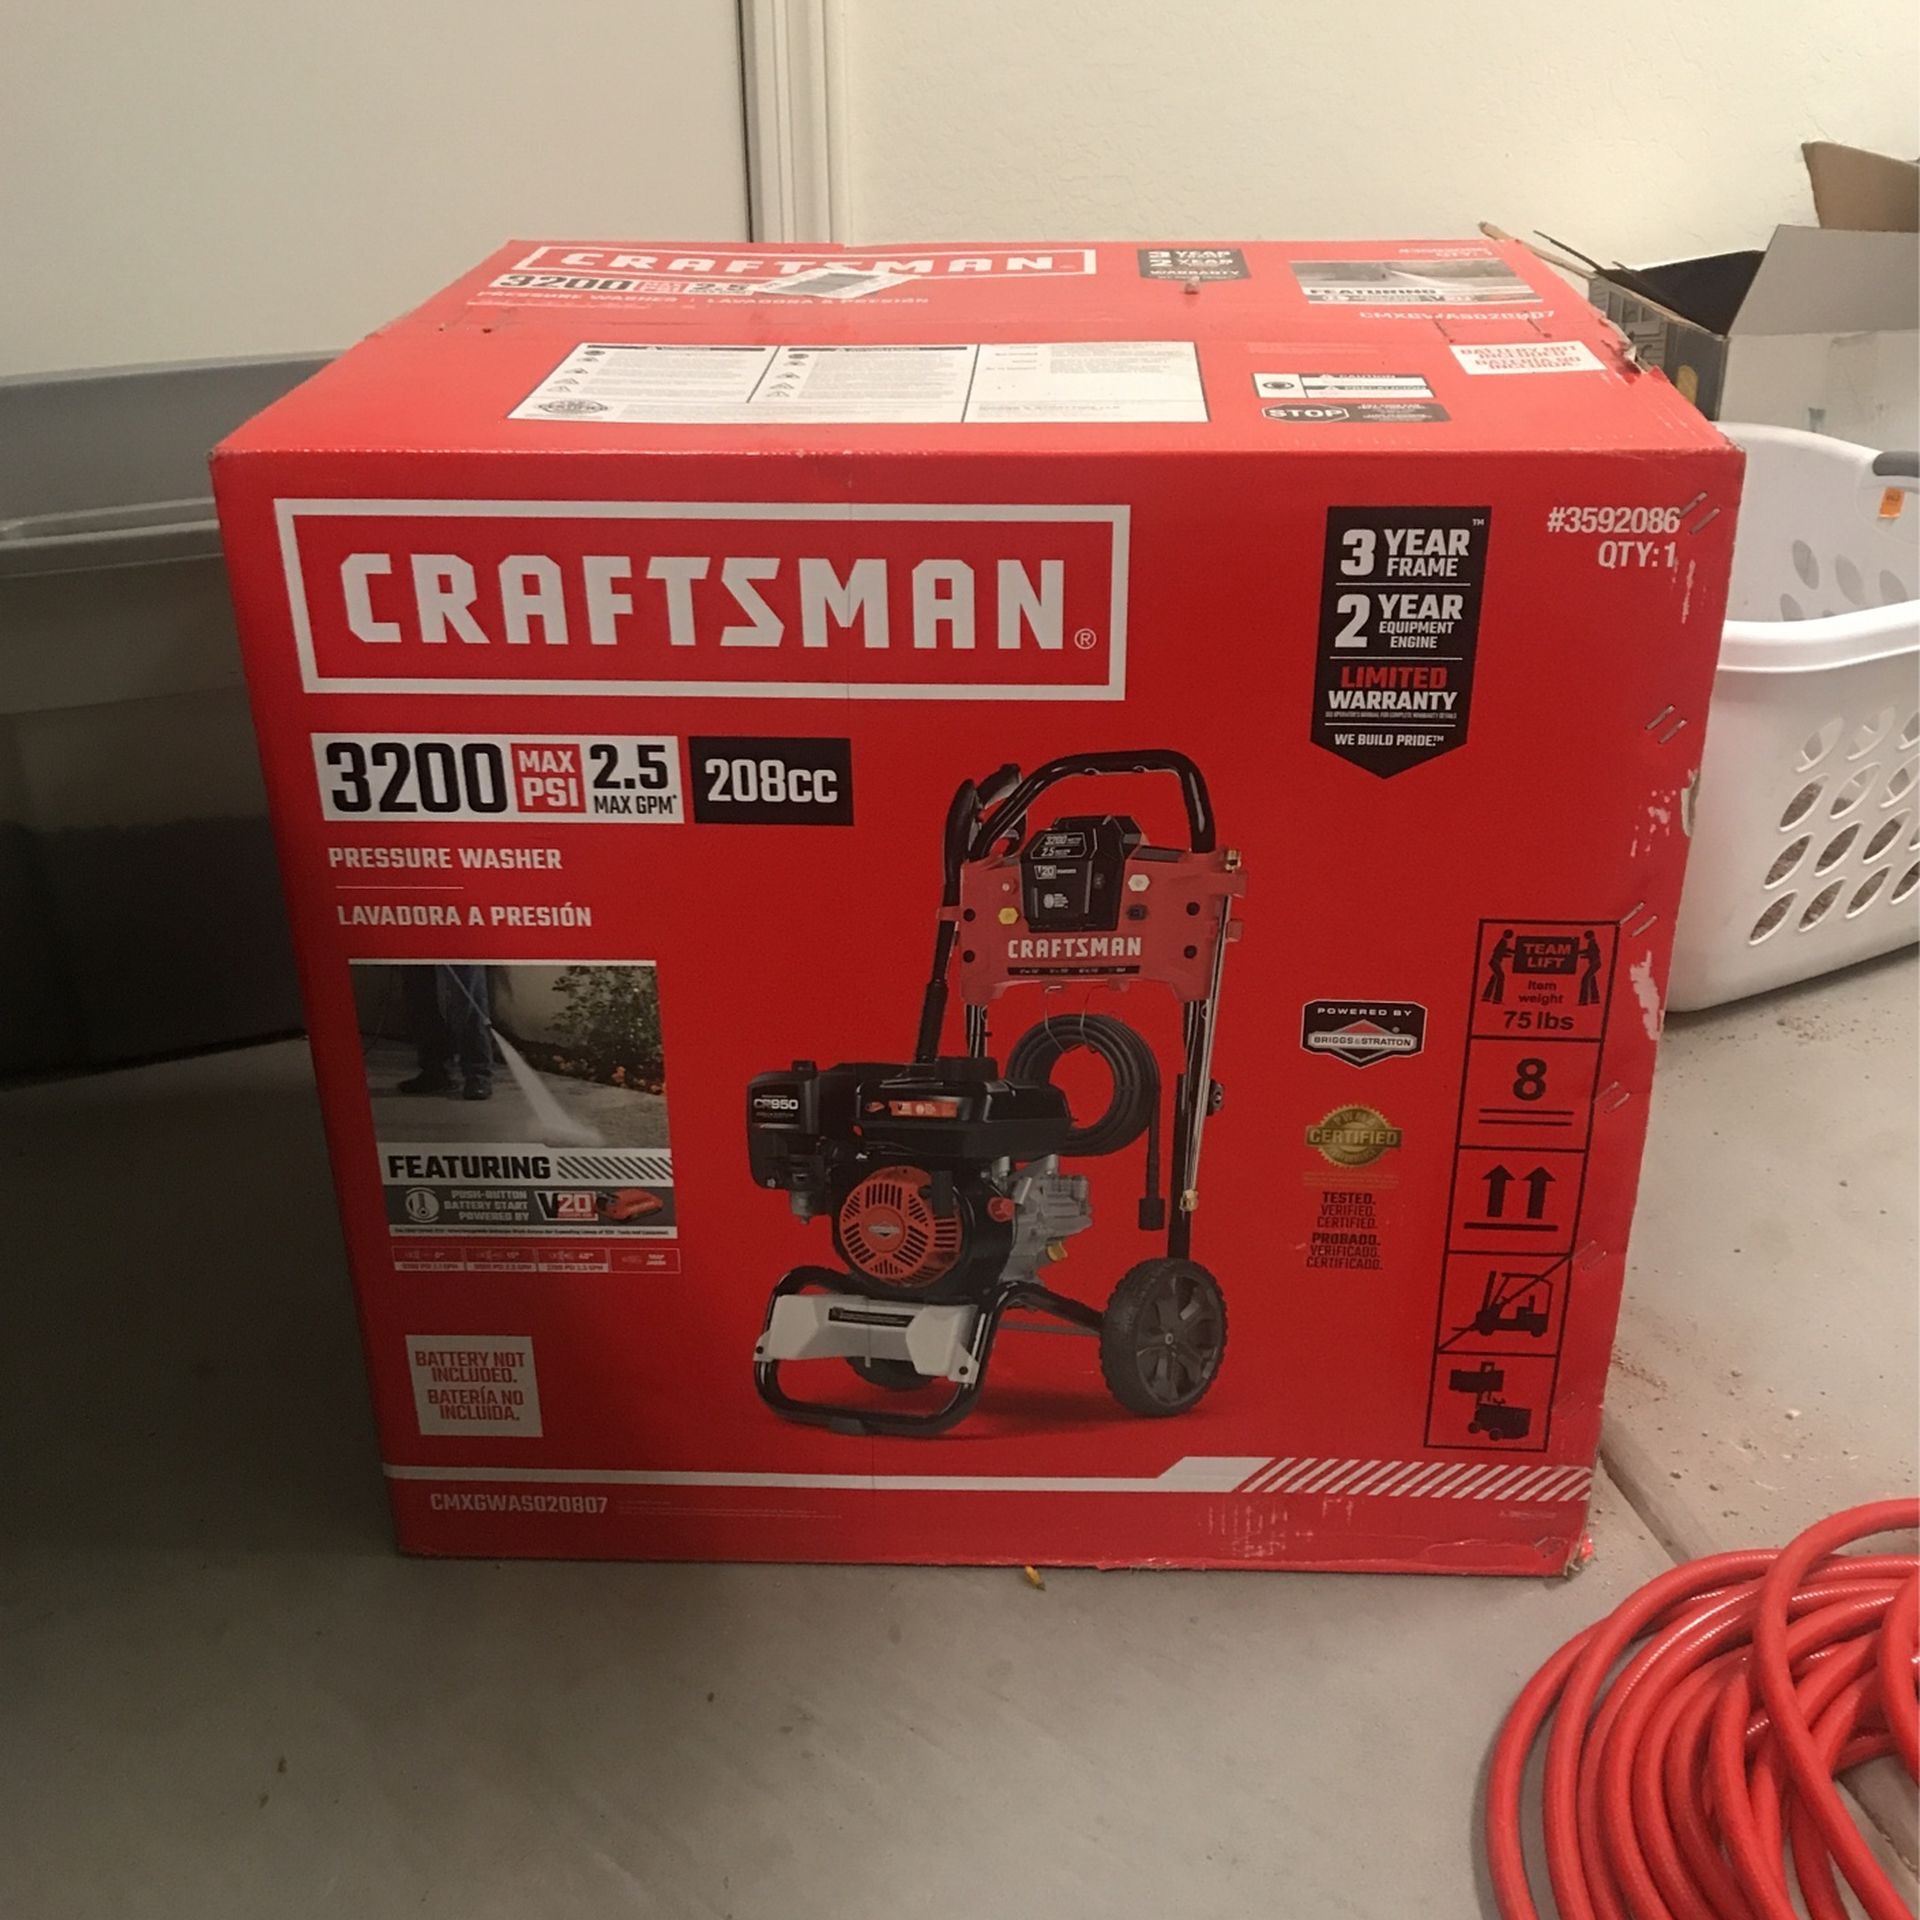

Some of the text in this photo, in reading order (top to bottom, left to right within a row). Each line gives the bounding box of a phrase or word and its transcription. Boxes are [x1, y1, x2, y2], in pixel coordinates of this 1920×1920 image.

[561, 253, 1053, 273] CRAFTSMAN
[500, 275, 634, 291] 3200
[1268, 409, 1344, 418] STOP
[1547, 506, 1681, 534] #3592086
[1340, 528, 1470, 577] 3 YEAR
[1386, 558, 1458, 577] FRAME
[1334, 594, 1463, 649] 2 YEAR
[1379, 620, 1453, 635] EQUIPMENT
[1390, 636, 1438, 649] ENGINE
[1340, 666, 1448, 690] LIMITED
[1328, 691, 1458, 711] WARRANTY
[1334, 733, 1355, 745] WE
[1357, 734, 1393, 746] BUILD
[518, 750, 575, 773] MAX
[590, 744, 669, 790] 2.5
[326, 742, 508, 814] 3200
[706, 758, 838, 803] 208cc
[523, 778, 579, 807] PSI
[594, 794, 633, 814] MAX
[328, 848, 562, 870] PRESSURE WASHER
[338, 902, 592, 928] LAVADORA A PRESIÓN
[1007, 936, 1142, 959] CRAFTSMAN
[1523, 943, 1571, 955] TEAM
[1527, 956, 1565, 968] LIFT
[1528, 980, 1557, 990] Item
[1518, 993, 1564, 1005] weight
[1317, 1007, 1413, 1017] POWERED BY
[1503, 1010, 1575, 1030] 75 lbs
[1512, 1058, 1547, 1101] 8
[1309, 1128, 1398, 1145] CERTIFIED
[388, 1155, 551, 1179] FEATURING
[451, 1189, 528, 1200] PUSH-BUTTON
[1322, 1191, 1376, 1205] TESTED.
[444, 1200, 528, 1210] BATTERY START
[1320, 1204, 1376, 1217] VERIFIED.
[459, 1211, 529, 1221] POWERED BY
[1317, 1216, 1378, 1229] CERTIFIED.
[1312, 1232, 1381, 1246] PROBADO.
[1310, 1245, 1381, 1258] VERIFICADO.
[1306, 1257, 1383, 1270] CERTIFICADO.
[415, 1351, 525, 1368] BATTERY NOT
[432, 1367, 518, 1384] INCLUDED.
[428, 1386, 524, 1406] BATERÍA NO
[440, 1404, 520, 1421] INCLUIDA.
[429, 1493, 608, 1515] CMXGWAS020807
